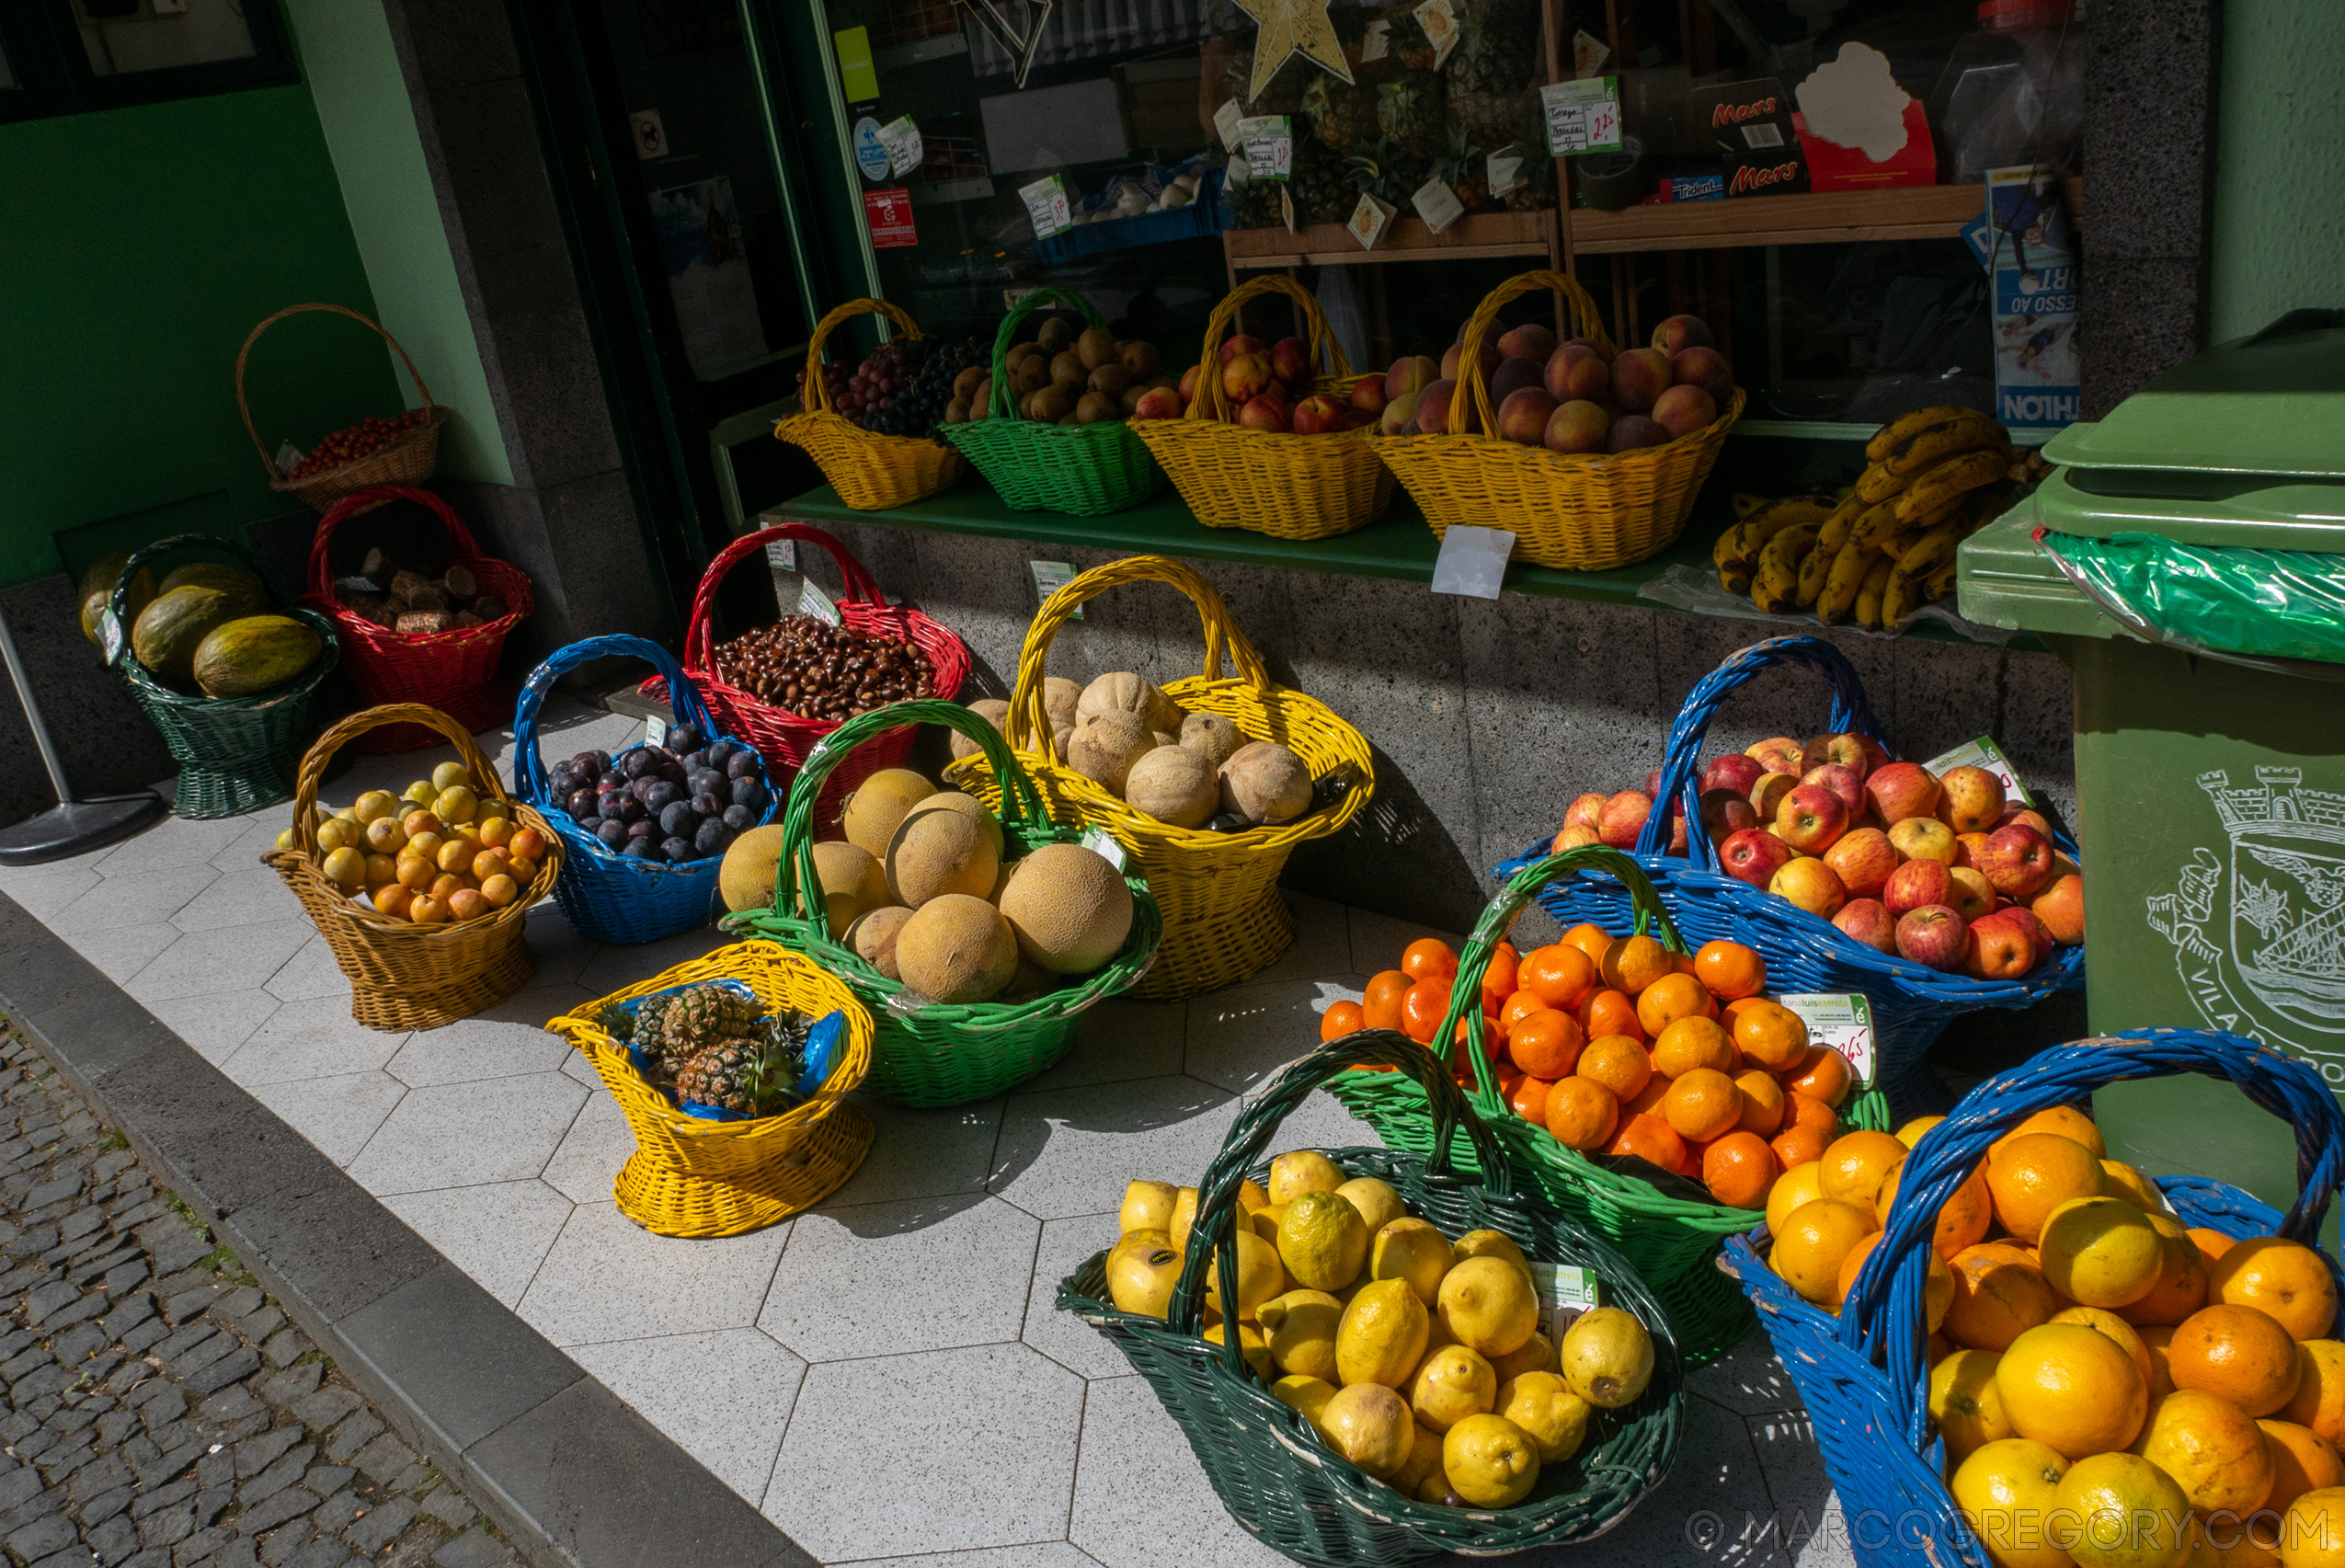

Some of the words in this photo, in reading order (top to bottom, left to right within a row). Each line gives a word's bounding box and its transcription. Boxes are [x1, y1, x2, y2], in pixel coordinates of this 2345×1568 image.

[1711, 97, 1777, 129] Mars
[1677, 178, 1718, 200] Trident
[1728, 161, 1799, 197] Mars
[2011, 296, 2032, 314] AO
[2191, 967, 2238, 1031] VILA
